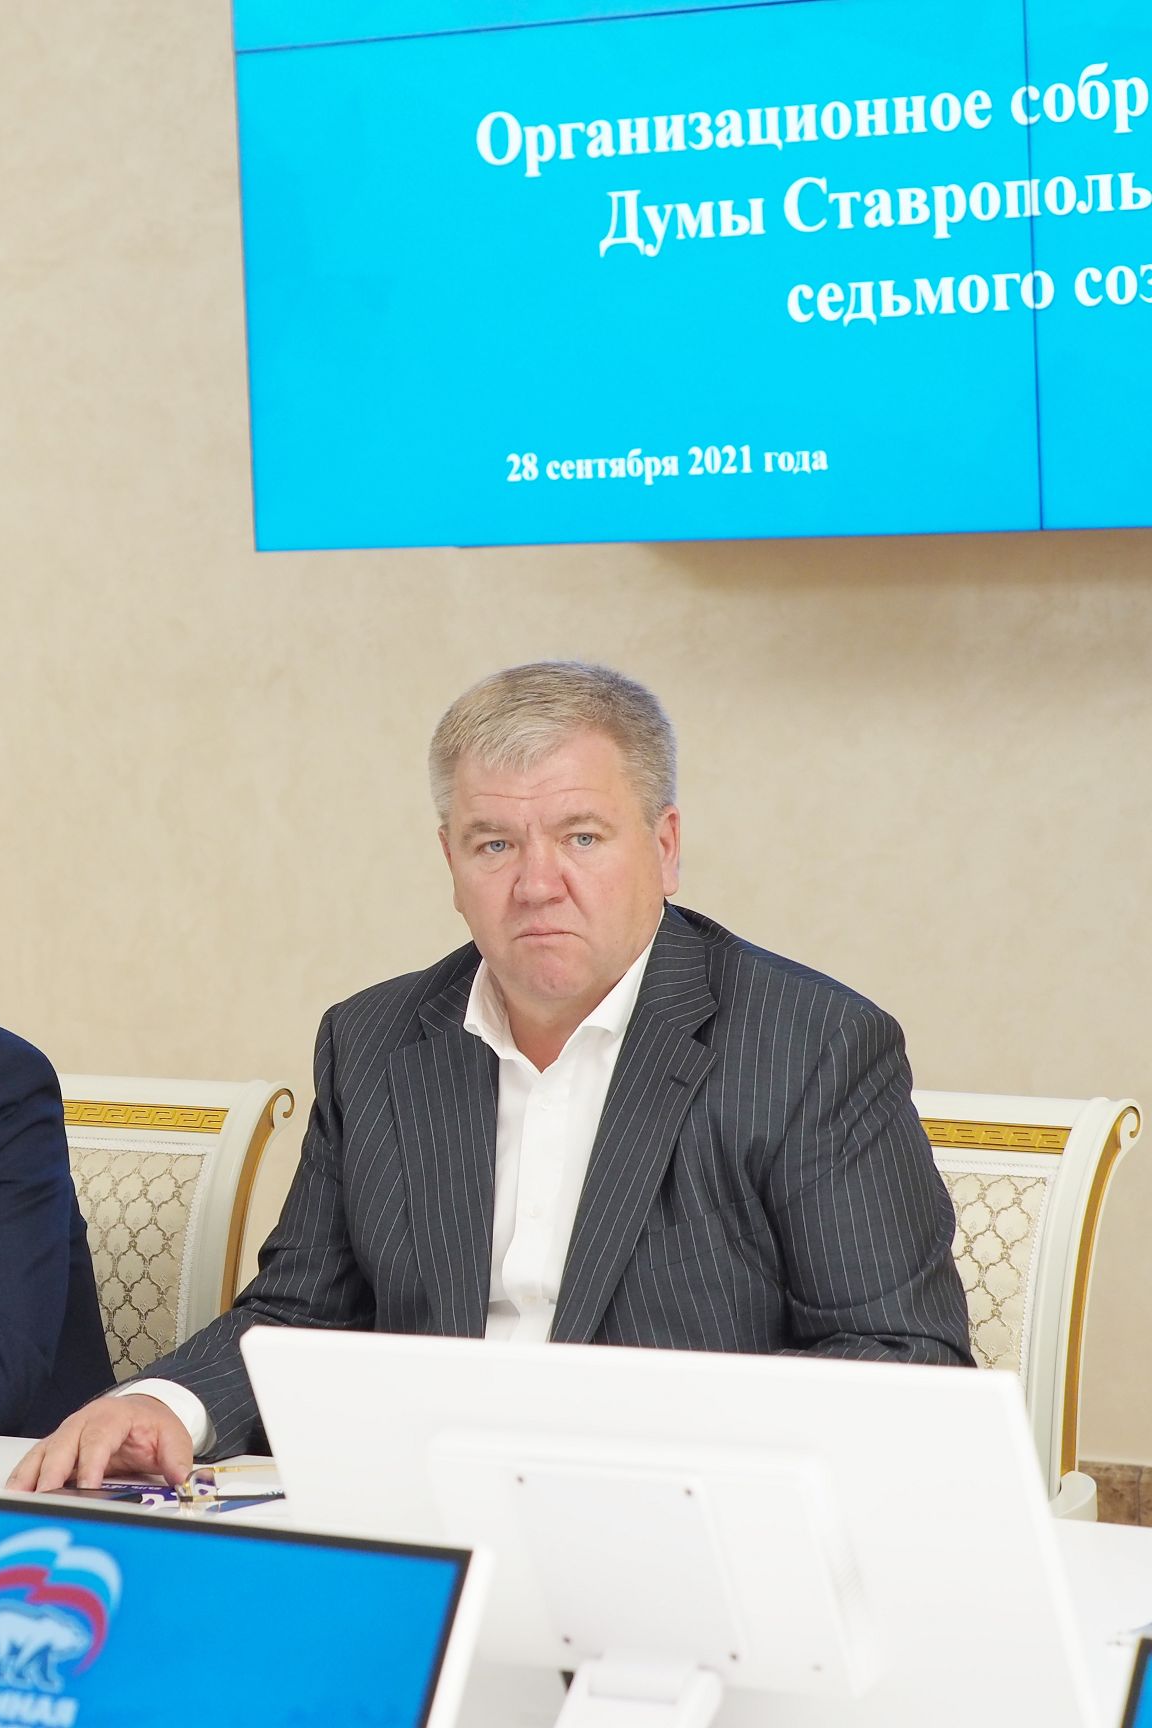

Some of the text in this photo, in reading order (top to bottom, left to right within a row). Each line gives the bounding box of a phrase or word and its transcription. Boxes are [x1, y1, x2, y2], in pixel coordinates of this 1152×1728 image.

[475, 61, 1150, 179] Организационное собр
[598, 171, 1152, 258] Думы Ставрополь
[786, 269, 1056, 327] седьмого
[506, 444, 828, 486] 28 сентября 2021 года
